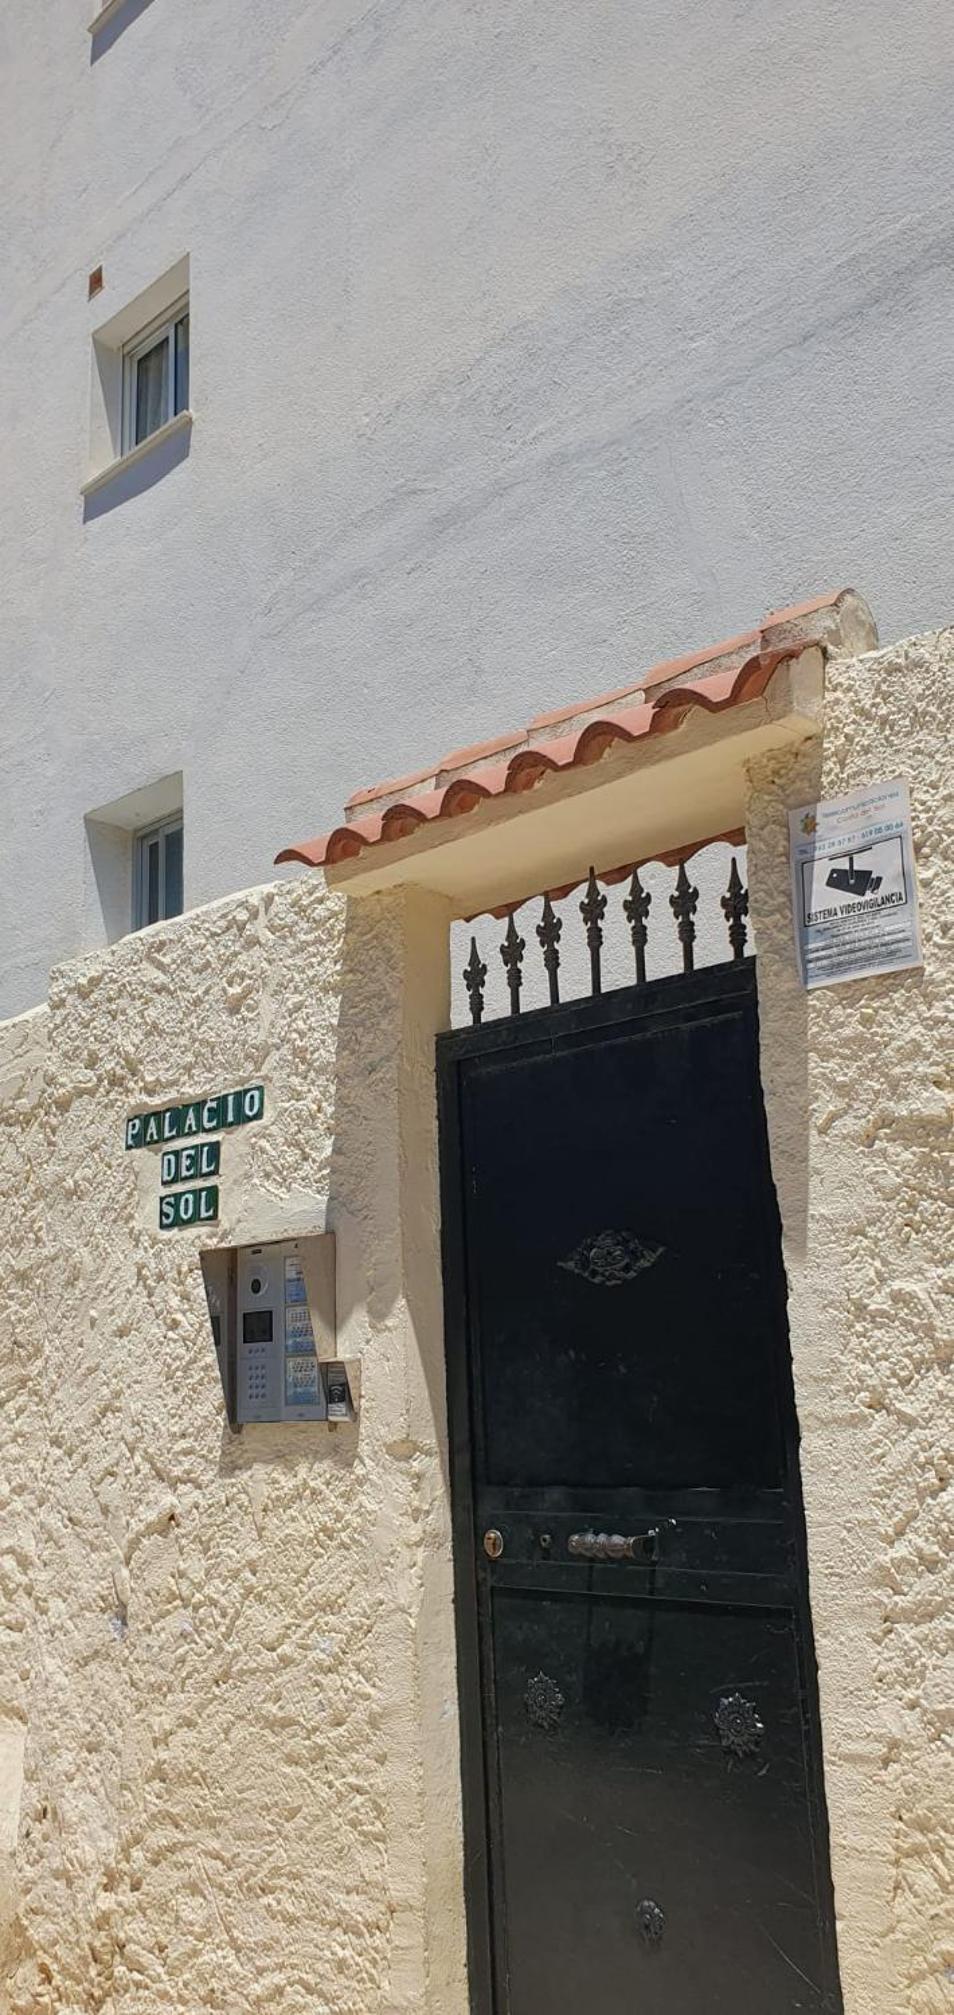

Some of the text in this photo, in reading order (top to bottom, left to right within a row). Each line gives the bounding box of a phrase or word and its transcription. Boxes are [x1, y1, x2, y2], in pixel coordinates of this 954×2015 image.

[806, 906, 838, 924] SISTEMA
[839, 891, 904, 915] VIDEOVIGILANCIA
[126, 1089, 260, 1147] PALACIO
[162, 1146, 216, 1182] DEL
[161, 1191, 214, 1225] SOL
